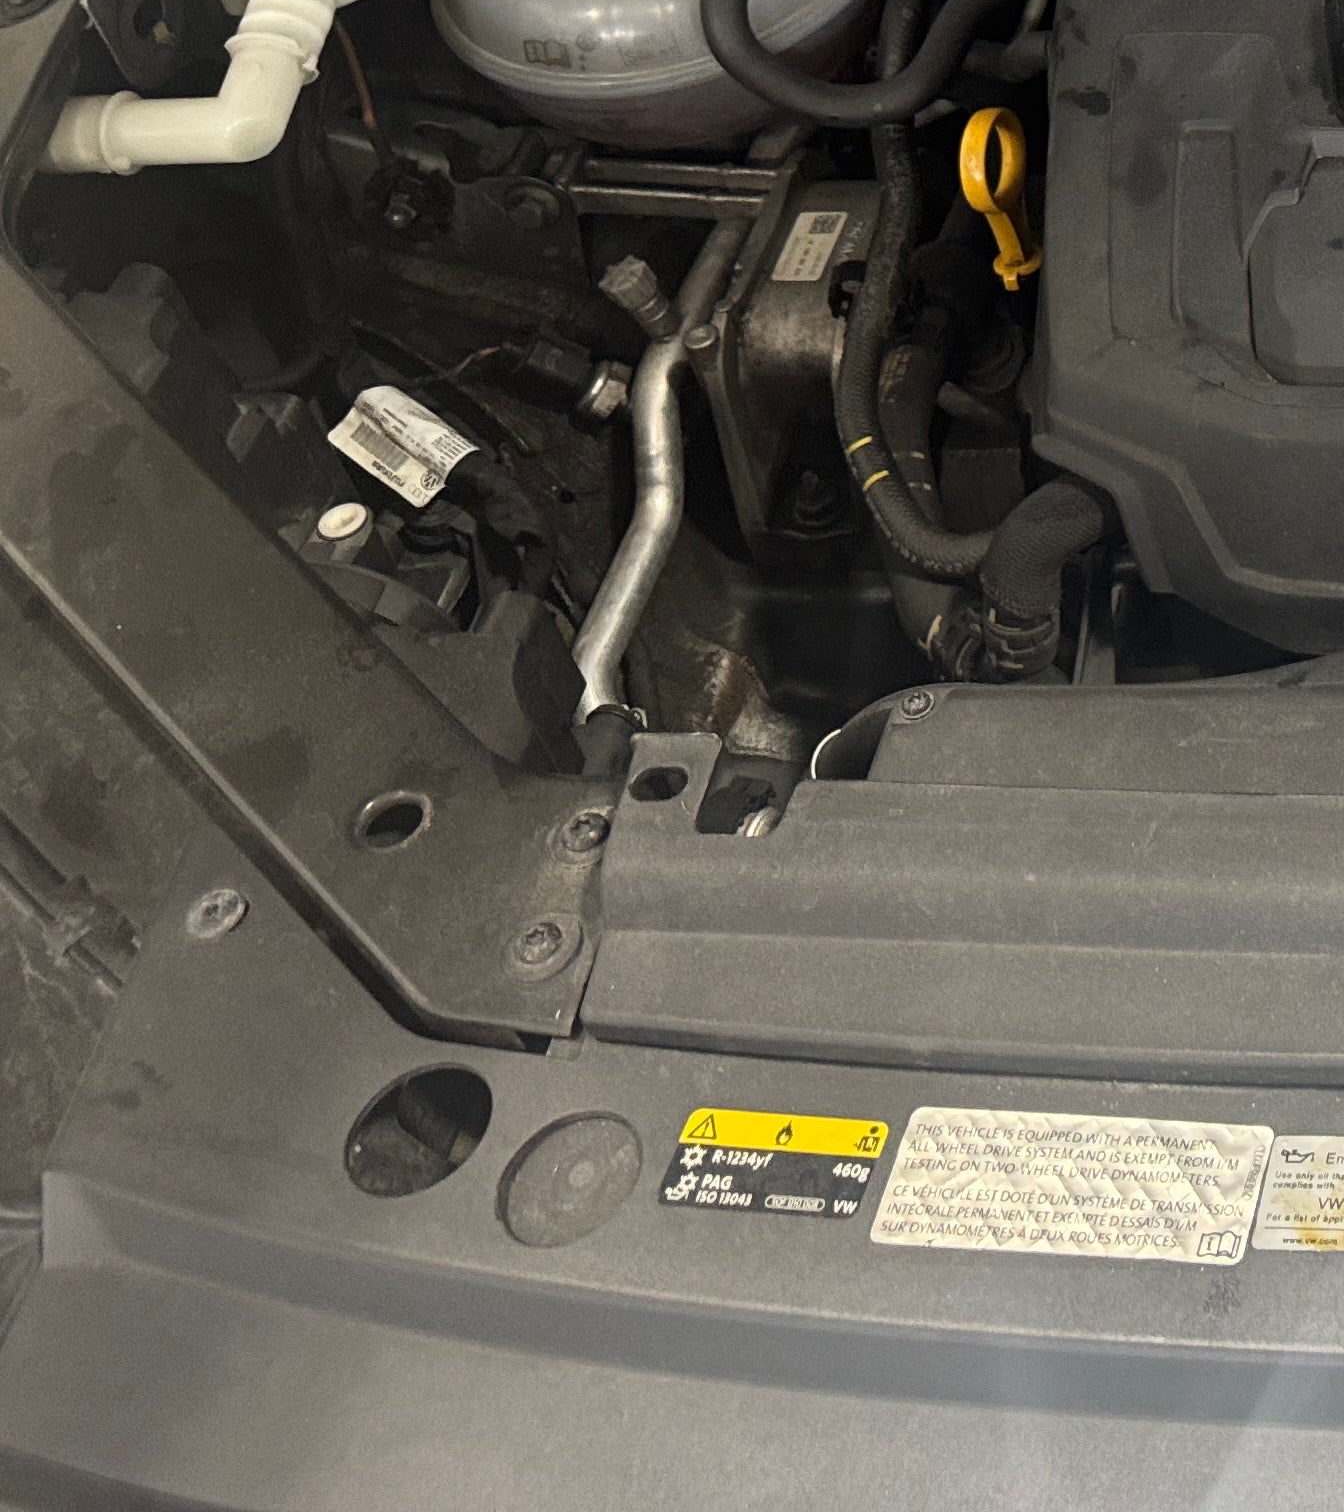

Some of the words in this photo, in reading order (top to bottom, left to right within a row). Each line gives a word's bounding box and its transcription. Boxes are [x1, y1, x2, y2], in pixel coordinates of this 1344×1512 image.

[916, 1124, 943, 1136] THIS
[948, 1125, 998, 1140] VEHICLE
[1002, 1128, 1014, 1140] IS
[1017, 1128, 1082, 1144] EQUIPPED
[1086, 1132, 1120, 1146] WITH
[1122, 1134, 1132, 1146] A
[1136, 1134, 1216, 1150] PERMANENT
[711, 1148, 774, 1170] R-1234yf
[982, 1143, 1020, 1158] DRIVE
[1025, 1146, 1074, 1160] SYSTEM
[1076, 1148, 1106, 1162] AND
[1109, 1151, 1120, 1163] IS
[1124, 1152, 1174, 1166] EXEMPT
[1178, 1154, 1214, 1168] FROM
[832, 1162, 871, 1184] 460g
[904, 1158, 960, 1172] TESTING
[960, 1159, 980, 1172] ON
[1069, 1167, 1106, 1180] DRIVE
[1275, 1171, 1292, 1179] Use
[1296, 1172, 1314, 1180] only
[700, 1173, 733, 1190] PAG
[1272, 1181, 1314, 1190] complies
[694, 1190, 718, 1204] ISO
[719, 1192, 753, 1207] 13043
[833, 1199, 858, 1214] VW
[892, 1184, 907, 1197] CE
[976, 1189, 998, 1202] EST
[1000, 1188, 1034, 1204] DOTÉ
[1036, 1192, 1070, 1206] D'UN
[1130, 1198, 1148, 1212] DE
[1319, 1198, 1344, 1210] VW
[956, 1206, 1032, 1222] PERMANENT
[1034, 1210, 1050, 1223] ET
[1294, 1214, 1306, 1222] list
[1310, 1214, 1320, 1222] of
[880, 1220, 908, 1232] SUR
[1030, 1228, 1064, 1242] DEUX
[1068, 1230, 1112, 1245] ROUES
